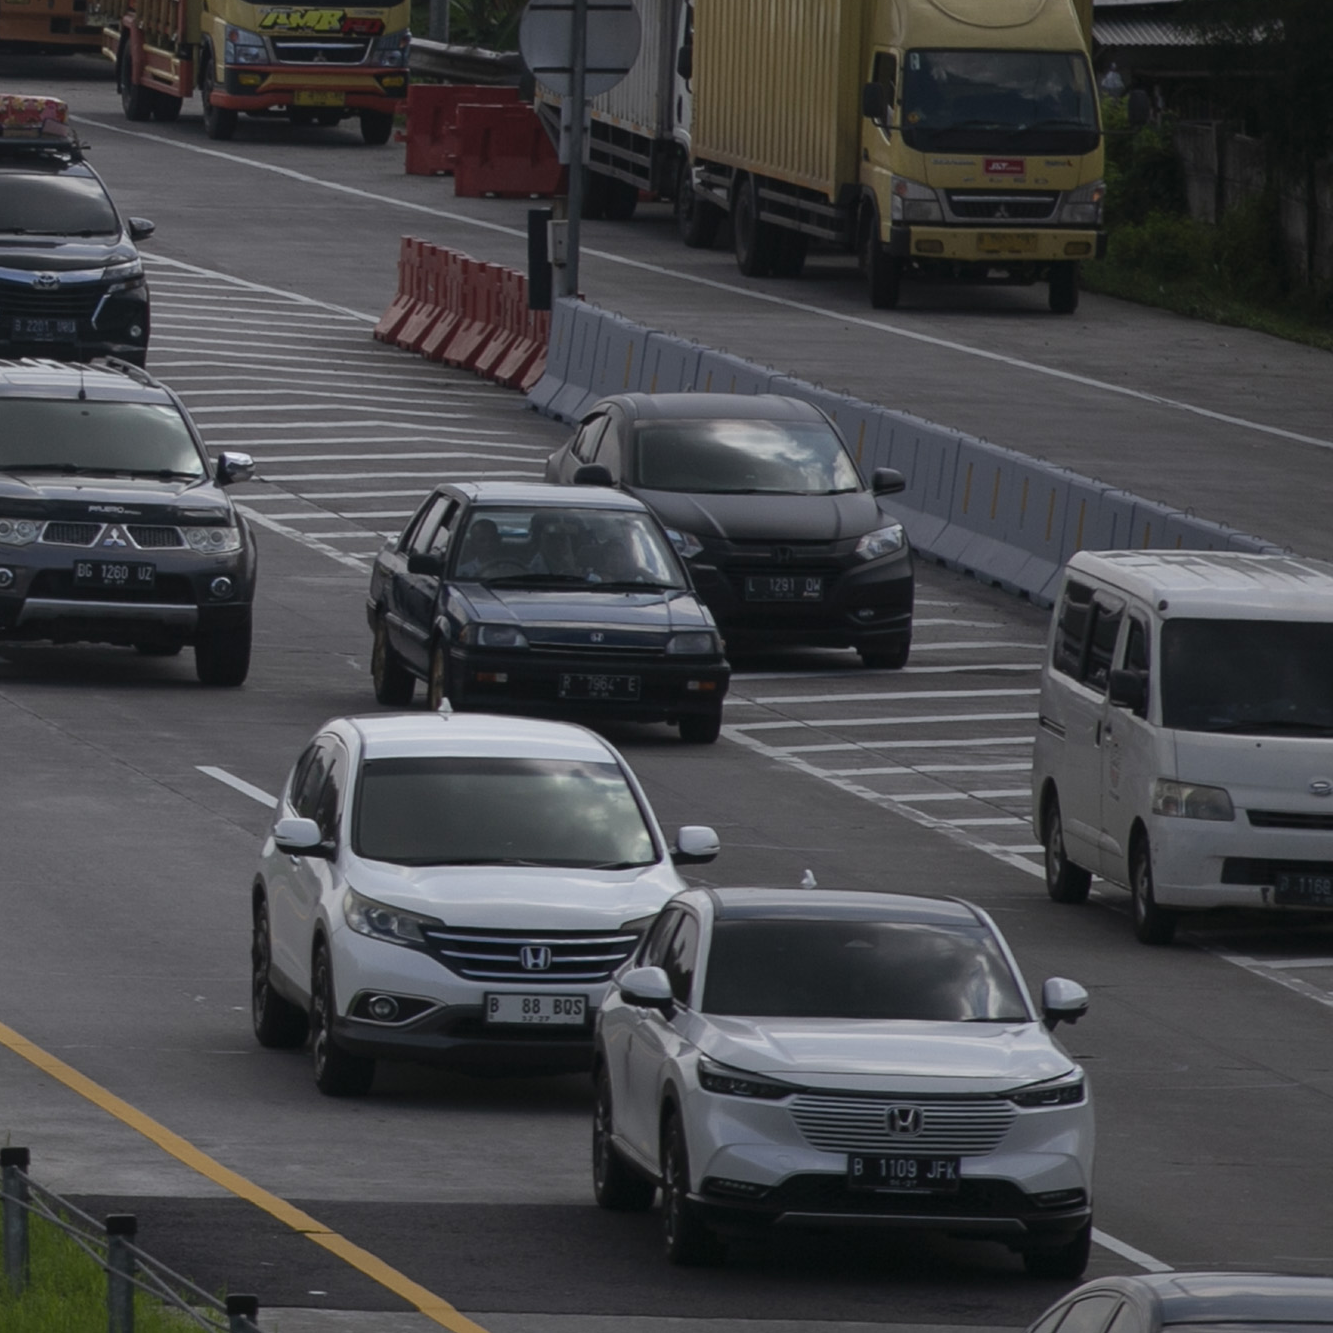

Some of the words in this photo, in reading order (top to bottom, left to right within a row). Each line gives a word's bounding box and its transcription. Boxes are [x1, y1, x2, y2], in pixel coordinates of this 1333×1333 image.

[77, 562, 93, 578] BG
[102, 564, 129, 580] 1260
[137, 566, 153, 581] UZ
[748, 578, 756, 592] L
[770, 577, 794, 592] 1291
[627, 677, 636, 691] E
[489, 997, 500, 1013] B
[522, 998, 541, 1015] 88
[552, 999, 583, 1016] BQS
[853, 1157, 863, 1177] B
[880, 1158, 917, 1177] 1109
[927, 1160, 957, 1179] JFK
